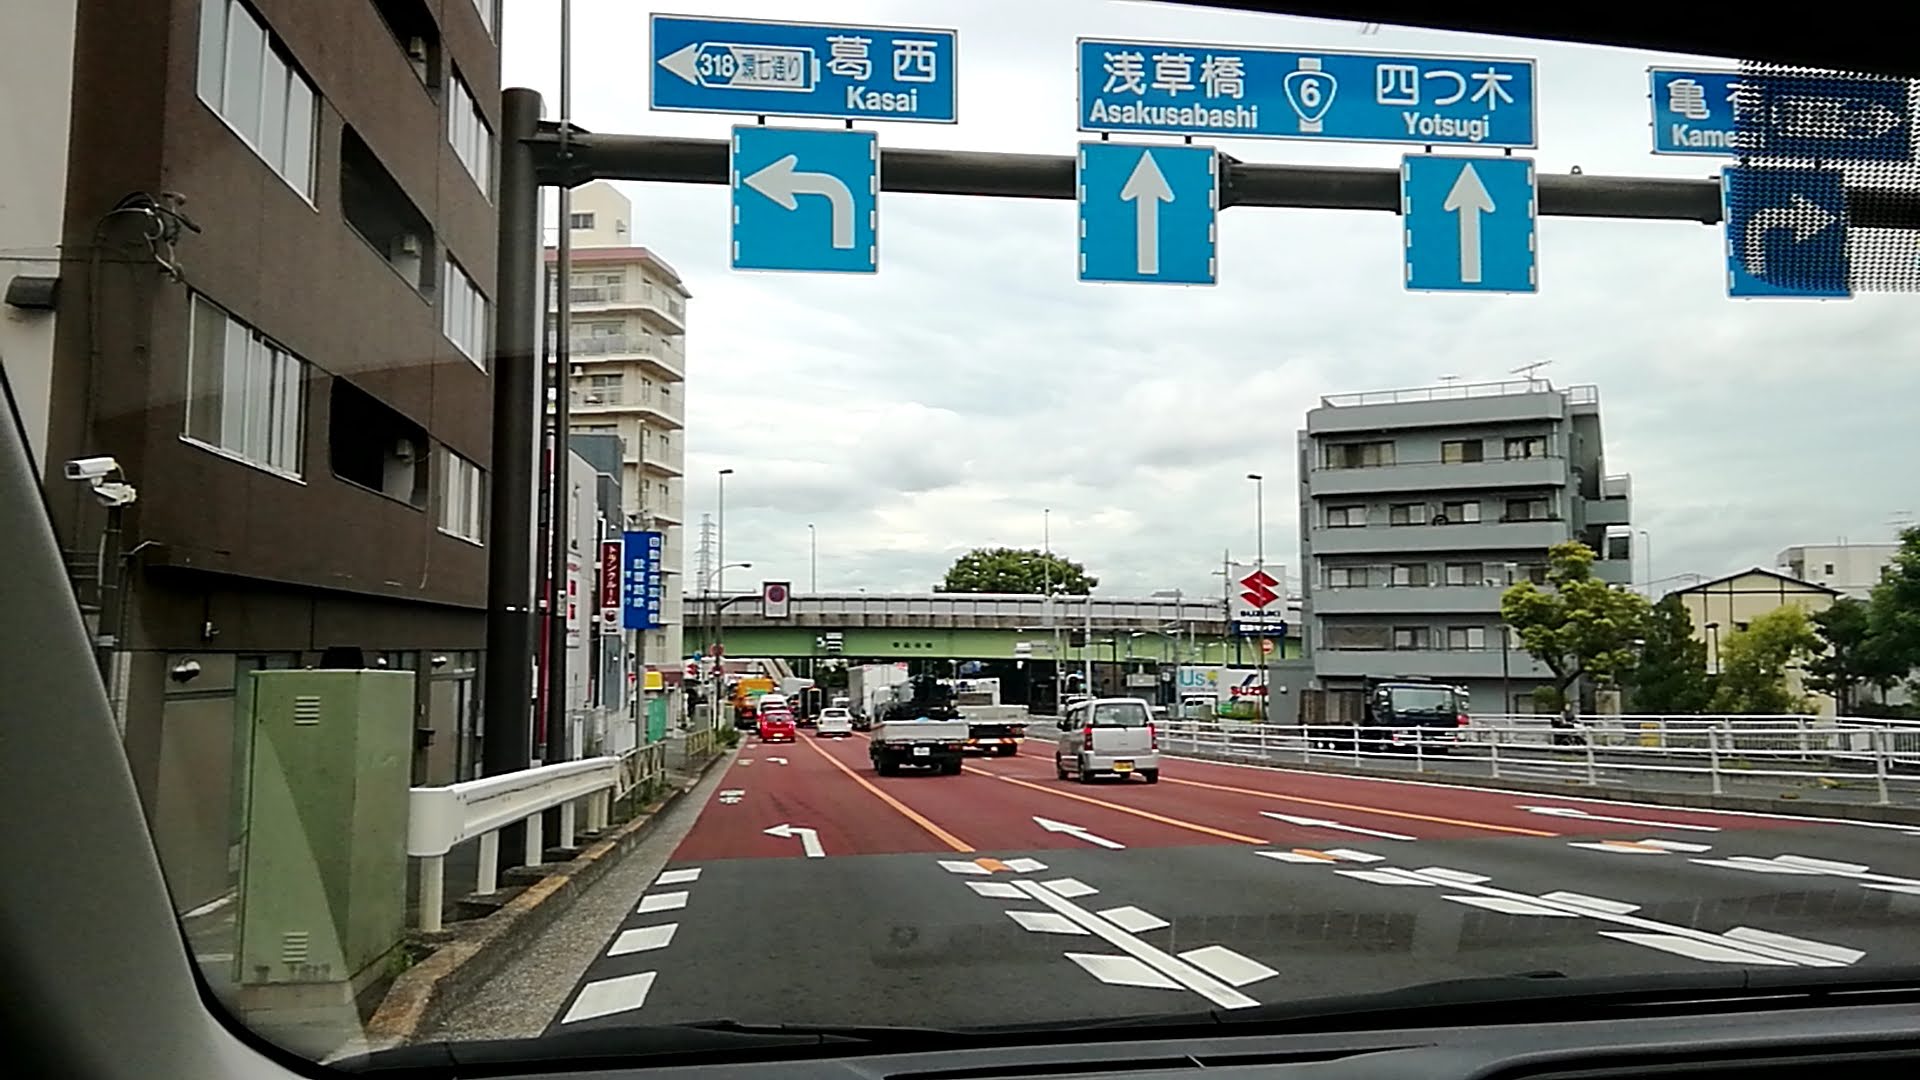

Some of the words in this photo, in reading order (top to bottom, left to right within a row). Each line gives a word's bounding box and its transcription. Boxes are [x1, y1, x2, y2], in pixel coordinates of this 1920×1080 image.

[700, 53, 735, 77] 318
[826, 35, 938, 83] 葛西
[1102, 51, 1245, 99] 浅草橋
[846, 85, 918, 112] Kasai
[1300, 78, 1320, 108] 6
[1376, 63, 1514, 111] 四つ木
[1089, 98, 1258, 129] Asakusabashi
[1403, 111, 1489, 143] Yotsugi
[606, 545, 618, 606] トランクルーム
